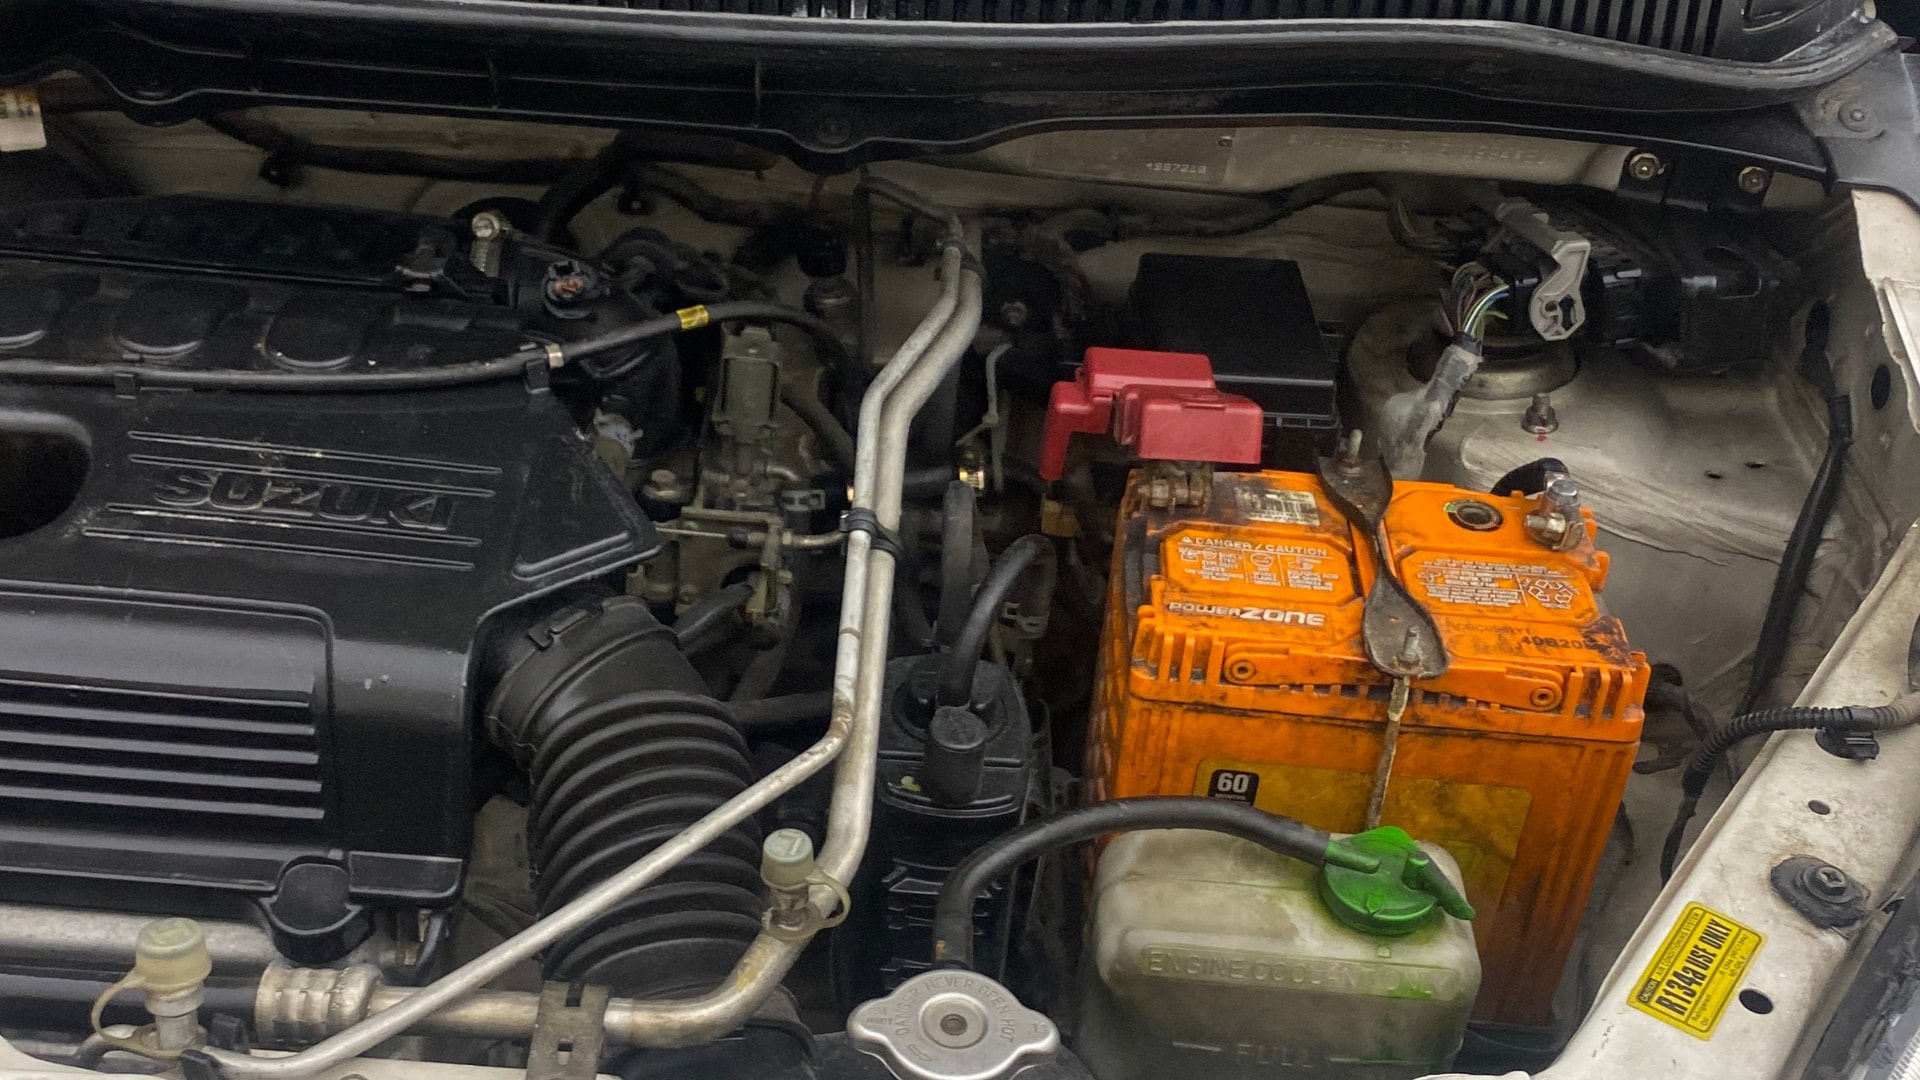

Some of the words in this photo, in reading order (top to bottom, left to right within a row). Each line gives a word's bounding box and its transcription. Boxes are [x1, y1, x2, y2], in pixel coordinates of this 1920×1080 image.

[152, 467, 453, 531] SUZUKI
[1195, 537, 1251, 550] DANGER
[1265, 543, 1327, 557] CAUTION
[1217, 772, 1249, 793] 60
[1698, 918, 1732, 950] ONLY
[1148, 951, 1247, 980] ENGINE
[1252, 961, 1374, 989] COOLANT
[1381, 968, 1450, 995] ONLY
[1685, 944, 1717, 971] USE
[1639, 980, 1658, 1002] CAUTION
[1655, 966, 1707, 1016] R134a
[895, 988, 921, 1036] DANGER
[923, 976, 974, 991] NEVER
[978, 984, 1011, 1014] OPEN
[1000, 1018, 1016, 1043] HOT
